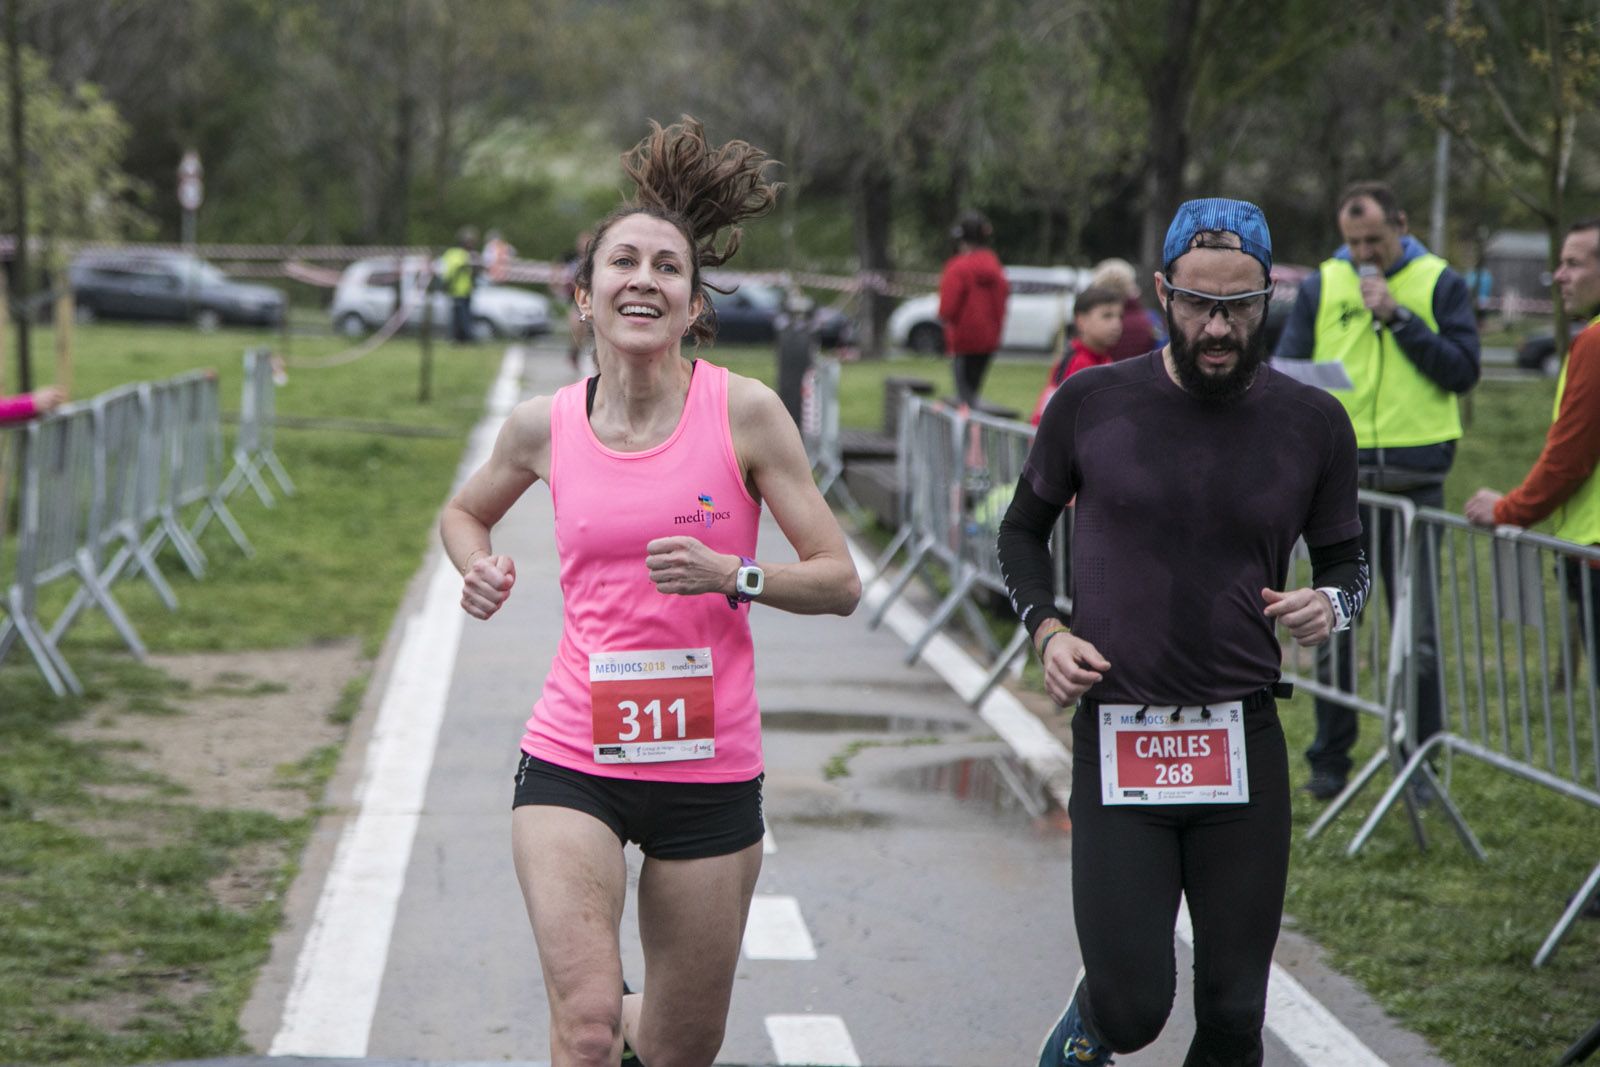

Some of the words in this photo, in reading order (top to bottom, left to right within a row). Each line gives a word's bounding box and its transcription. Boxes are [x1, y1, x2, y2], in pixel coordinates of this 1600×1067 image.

[617, 698, 687, 742] 311
[1135, 735, 1211, 759] CARLES
[1155, 763, 1193, 785] 268
